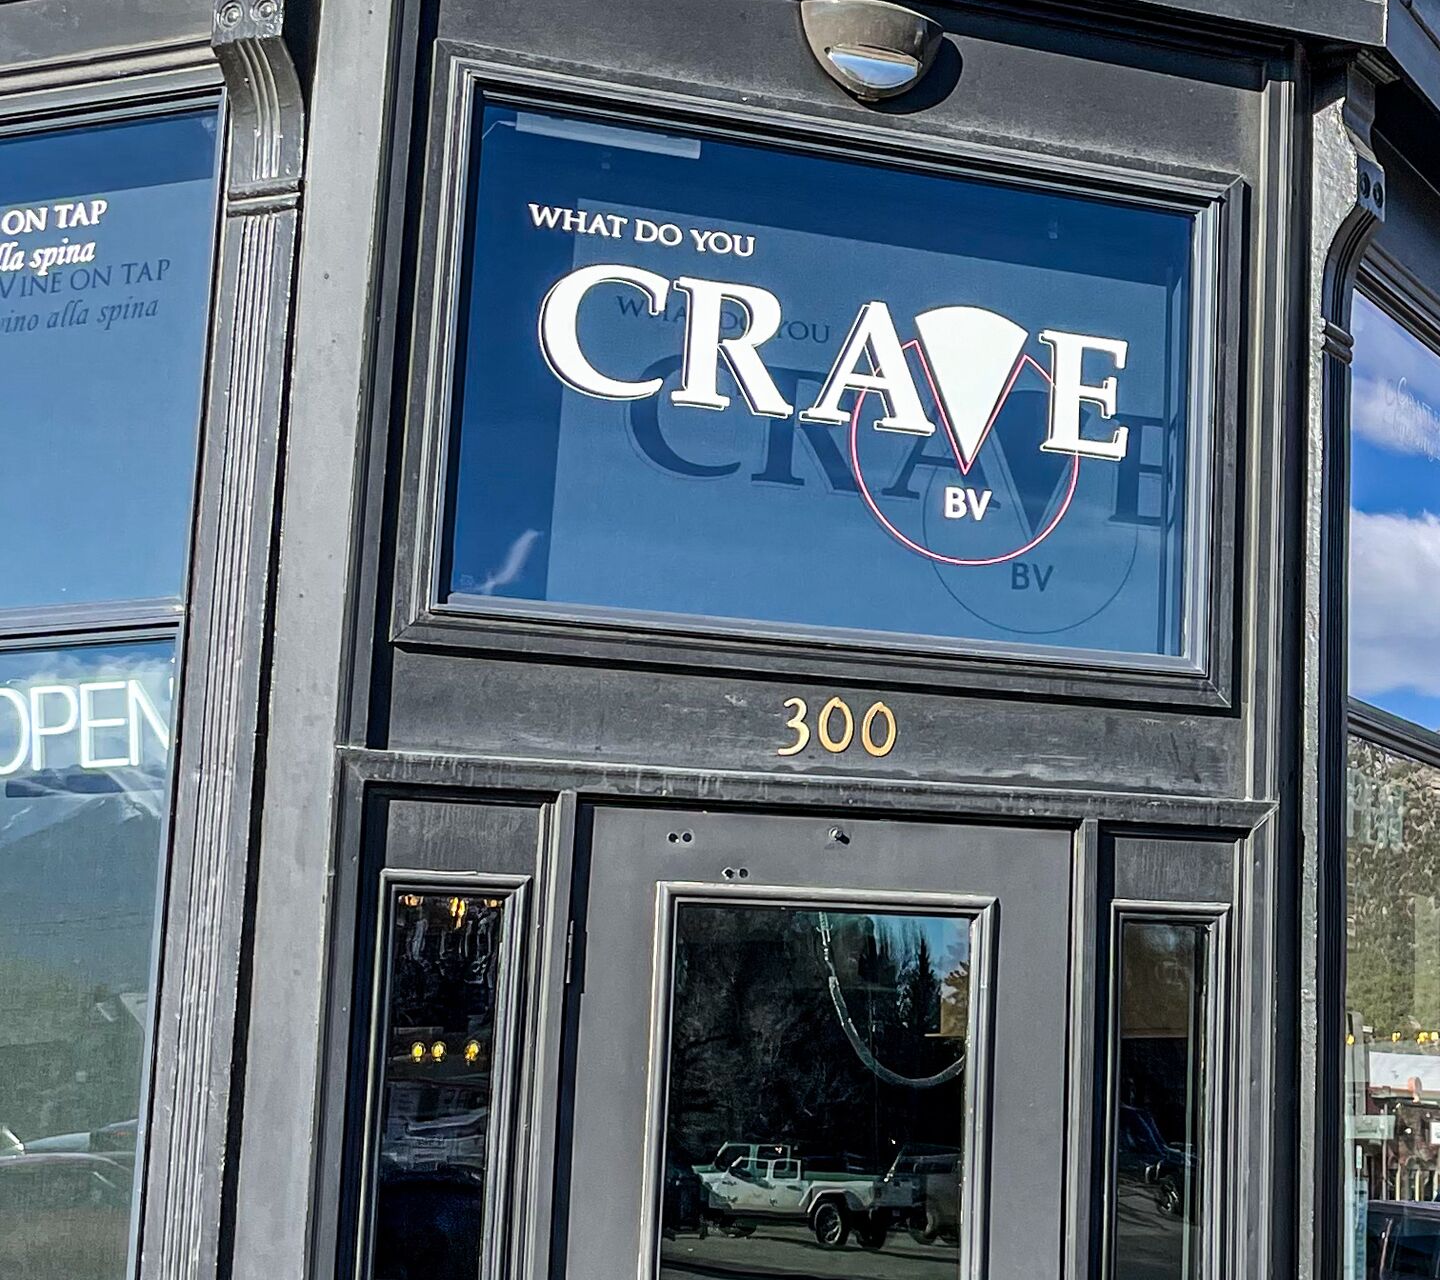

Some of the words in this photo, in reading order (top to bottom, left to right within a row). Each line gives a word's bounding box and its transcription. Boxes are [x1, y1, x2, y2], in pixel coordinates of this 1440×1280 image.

[1, 206, 48, 236] ON
[53, 199, 108, 229] TAP
[528, 203, 628, 239] WHAT
[634, 218, 683, 247] DO
[689, 228, 756, 258] YOU
[0, 241, 25, 272] lla
[29, 237, 96, 276] spina
[537, 263, 1129, 466] CRAVE
[944, 486, 992, 521] BV
[777, 695, 898, 757] 300
